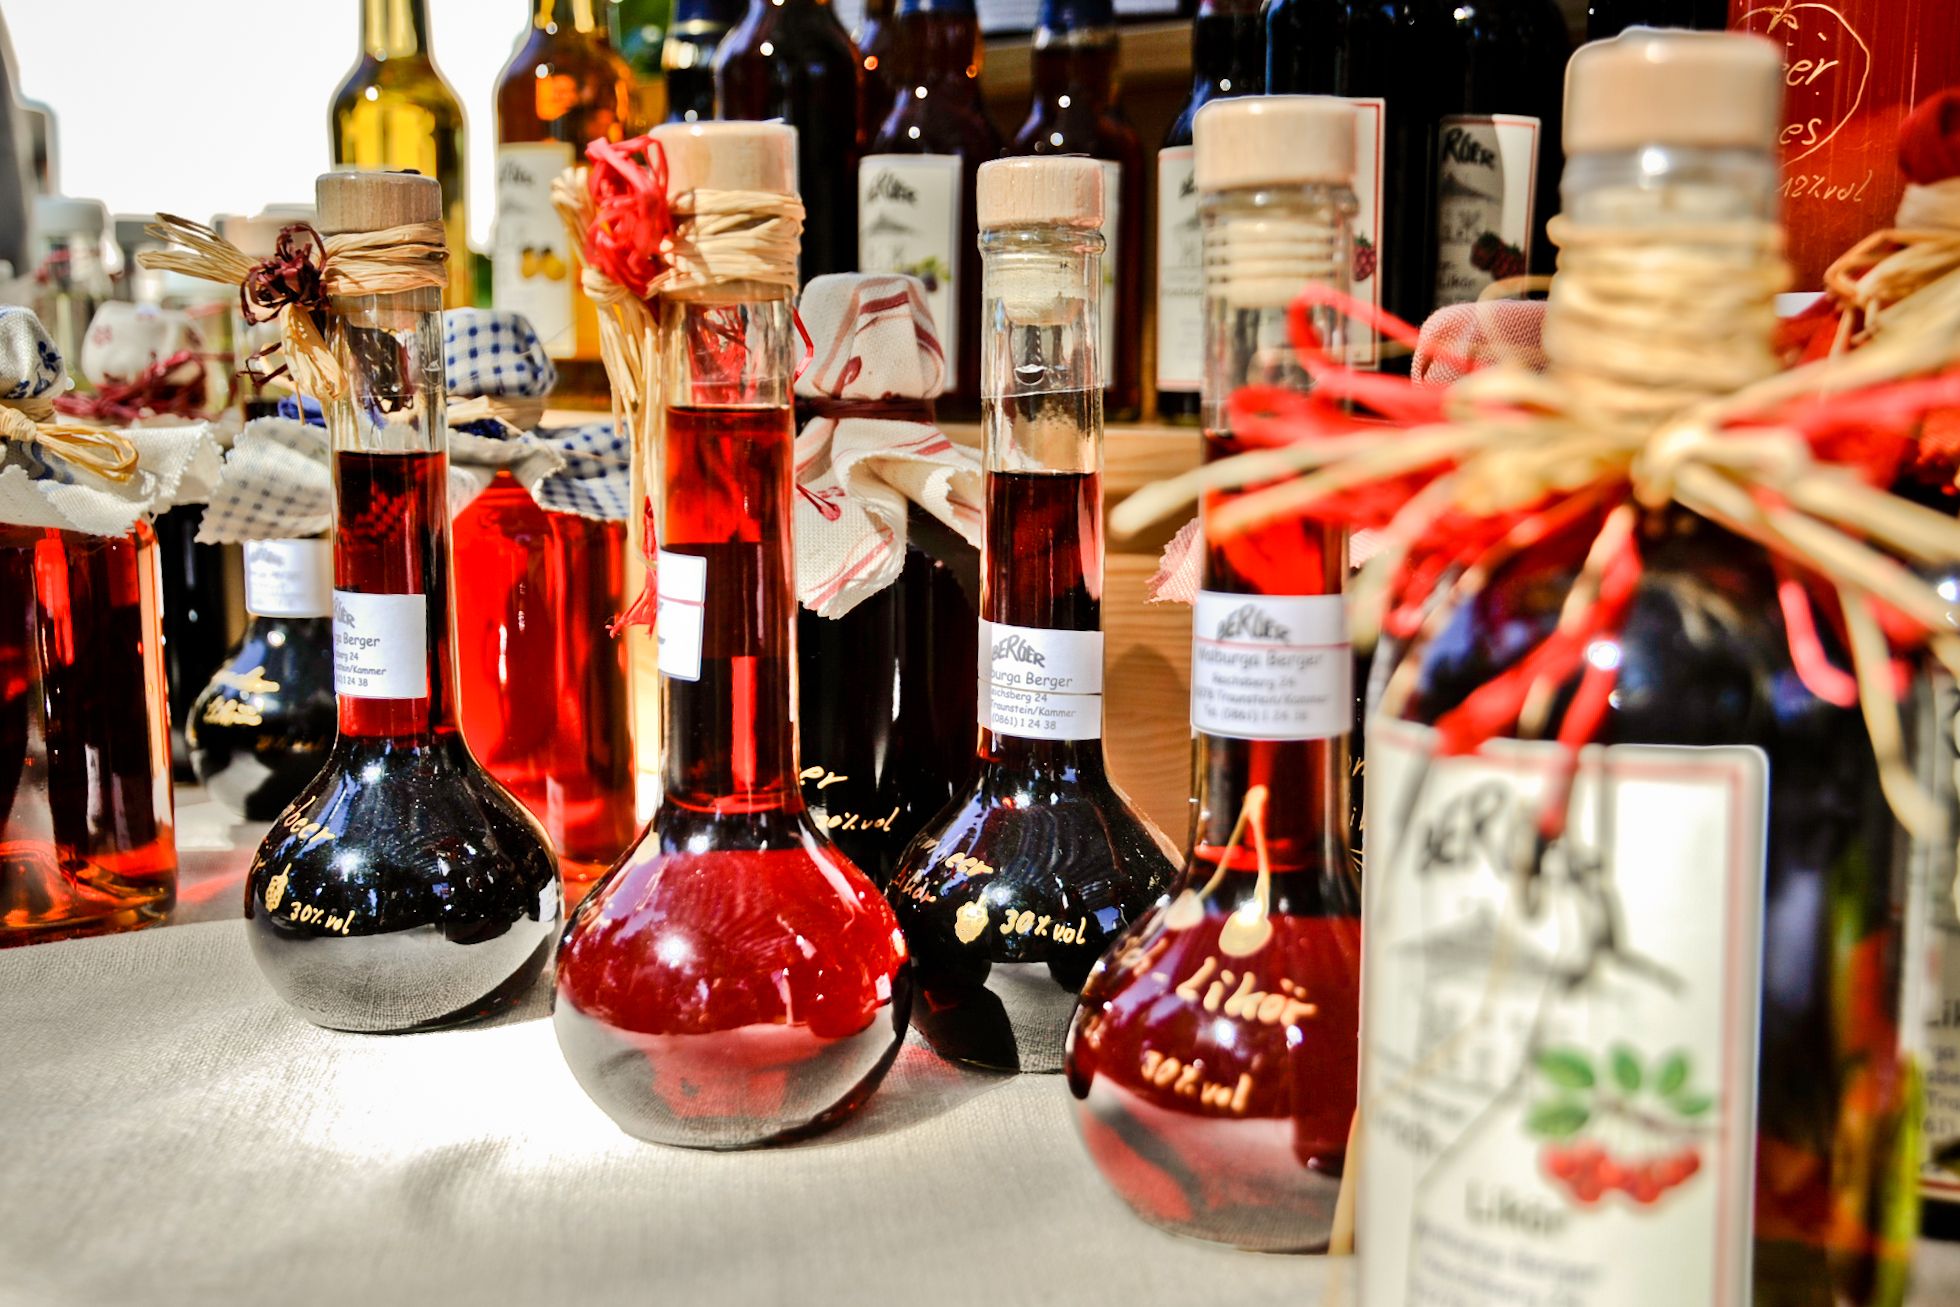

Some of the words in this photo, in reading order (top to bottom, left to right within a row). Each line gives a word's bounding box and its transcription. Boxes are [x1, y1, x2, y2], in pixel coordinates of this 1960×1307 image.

[343, 631, 381, 650] Berger
[991, 634, 1046, 669] BERGER
[1025, 671, 1073, 691] Berger
[991, 688, 1032, 705] eichsberg
[1034, 692, 1048, 703] 24
[992, 699, 1077, 718] raunstein/Kammer
[1027, 717, 1041, 729] 24
[1043, 719, 1057, 731] 38
[800, 765, 848, 790] er
